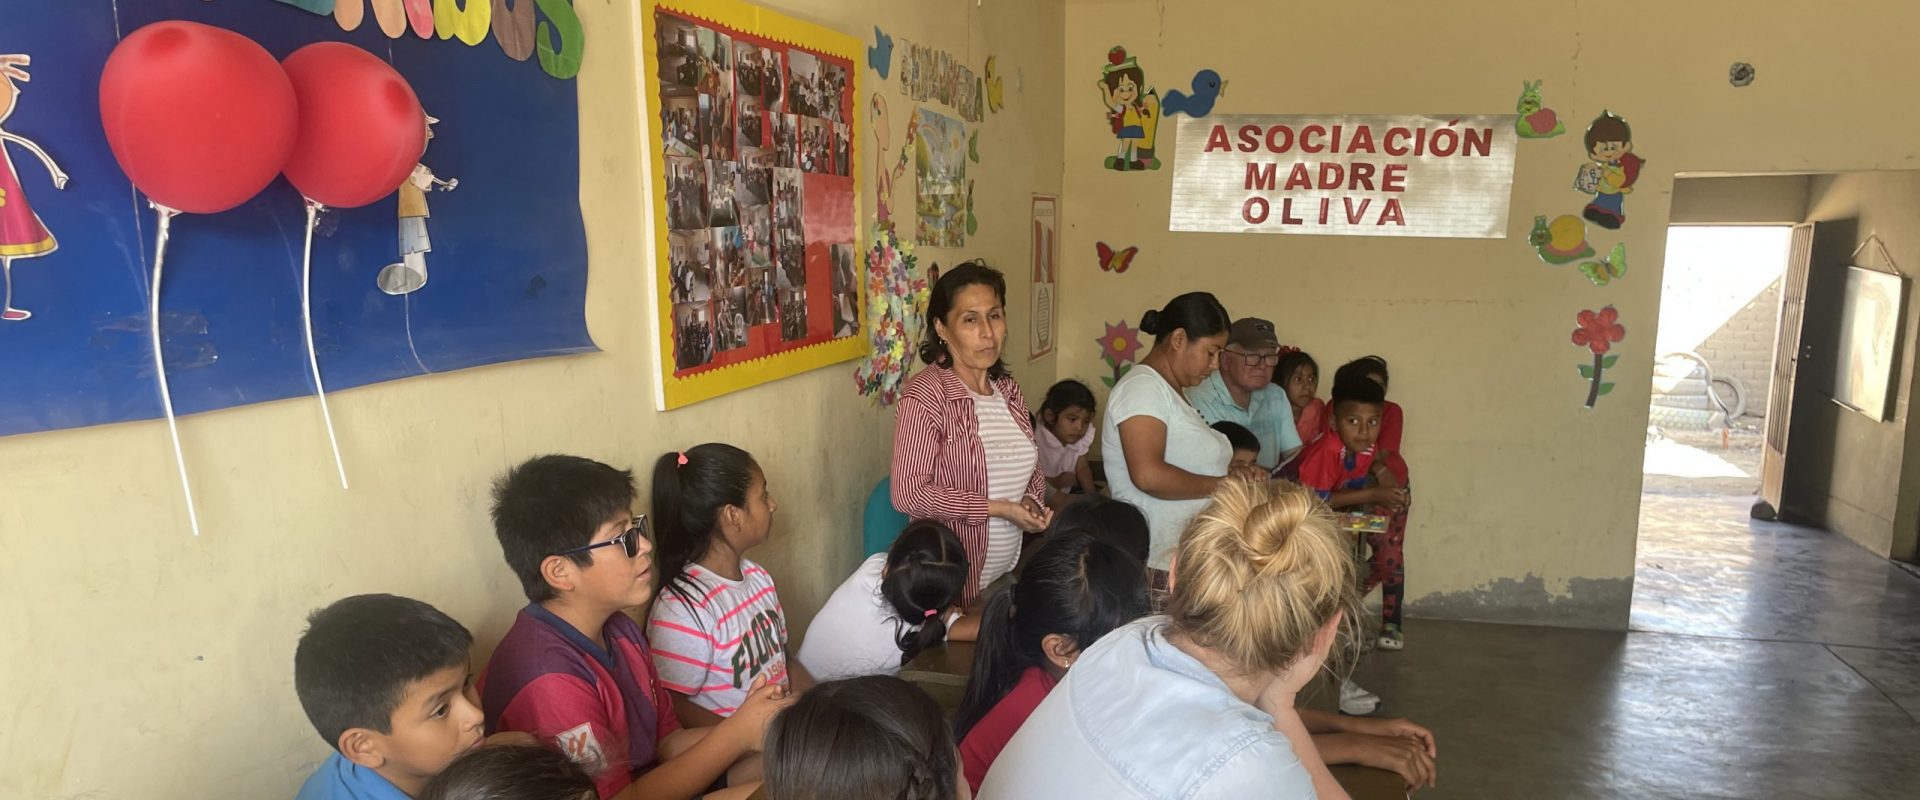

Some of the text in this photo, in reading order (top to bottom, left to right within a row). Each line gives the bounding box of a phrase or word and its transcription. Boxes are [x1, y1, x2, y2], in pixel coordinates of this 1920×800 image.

[1204, 119, 1493, 157] ASOCIACIÓN
[1244, 162, 1408, 192] MADRE
[1242, 196, 1406, 226] OLIVA
